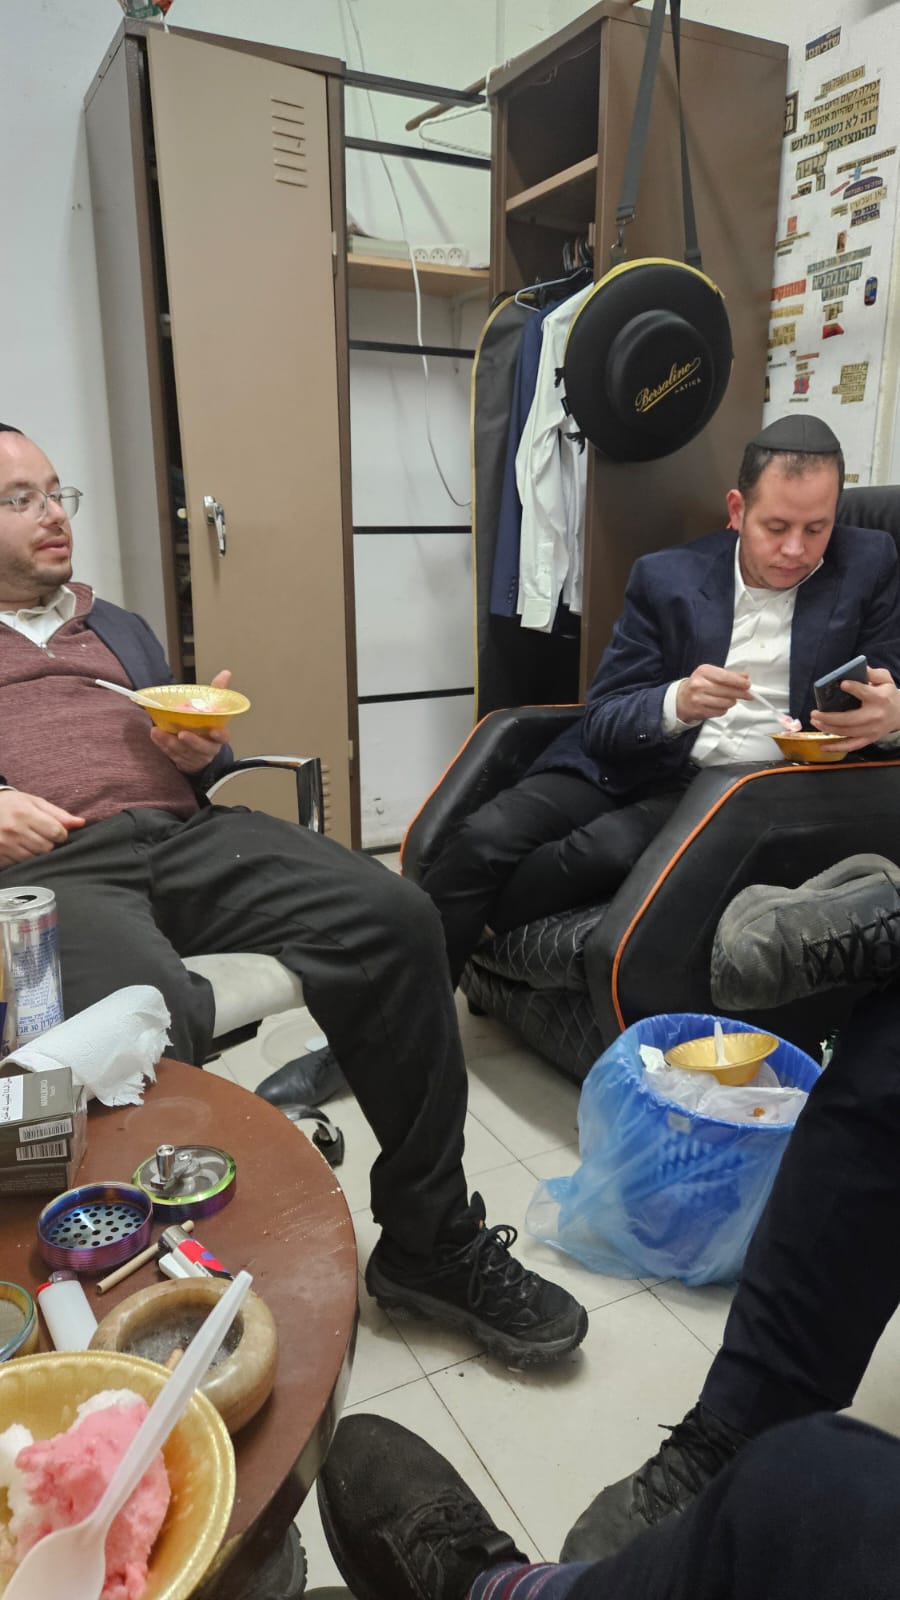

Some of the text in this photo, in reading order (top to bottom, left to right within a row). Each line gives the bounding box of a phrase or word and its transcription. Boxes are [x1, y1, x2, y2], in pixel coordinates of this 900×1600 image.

[816, 121, 843, 141] נשמע
[845, 113, 858, 129] לא
[791, 132, 815, 150] תלוש
[826, 124, 876, 151] מהמציאות
[634, 357, 701, 412] Borsalino
